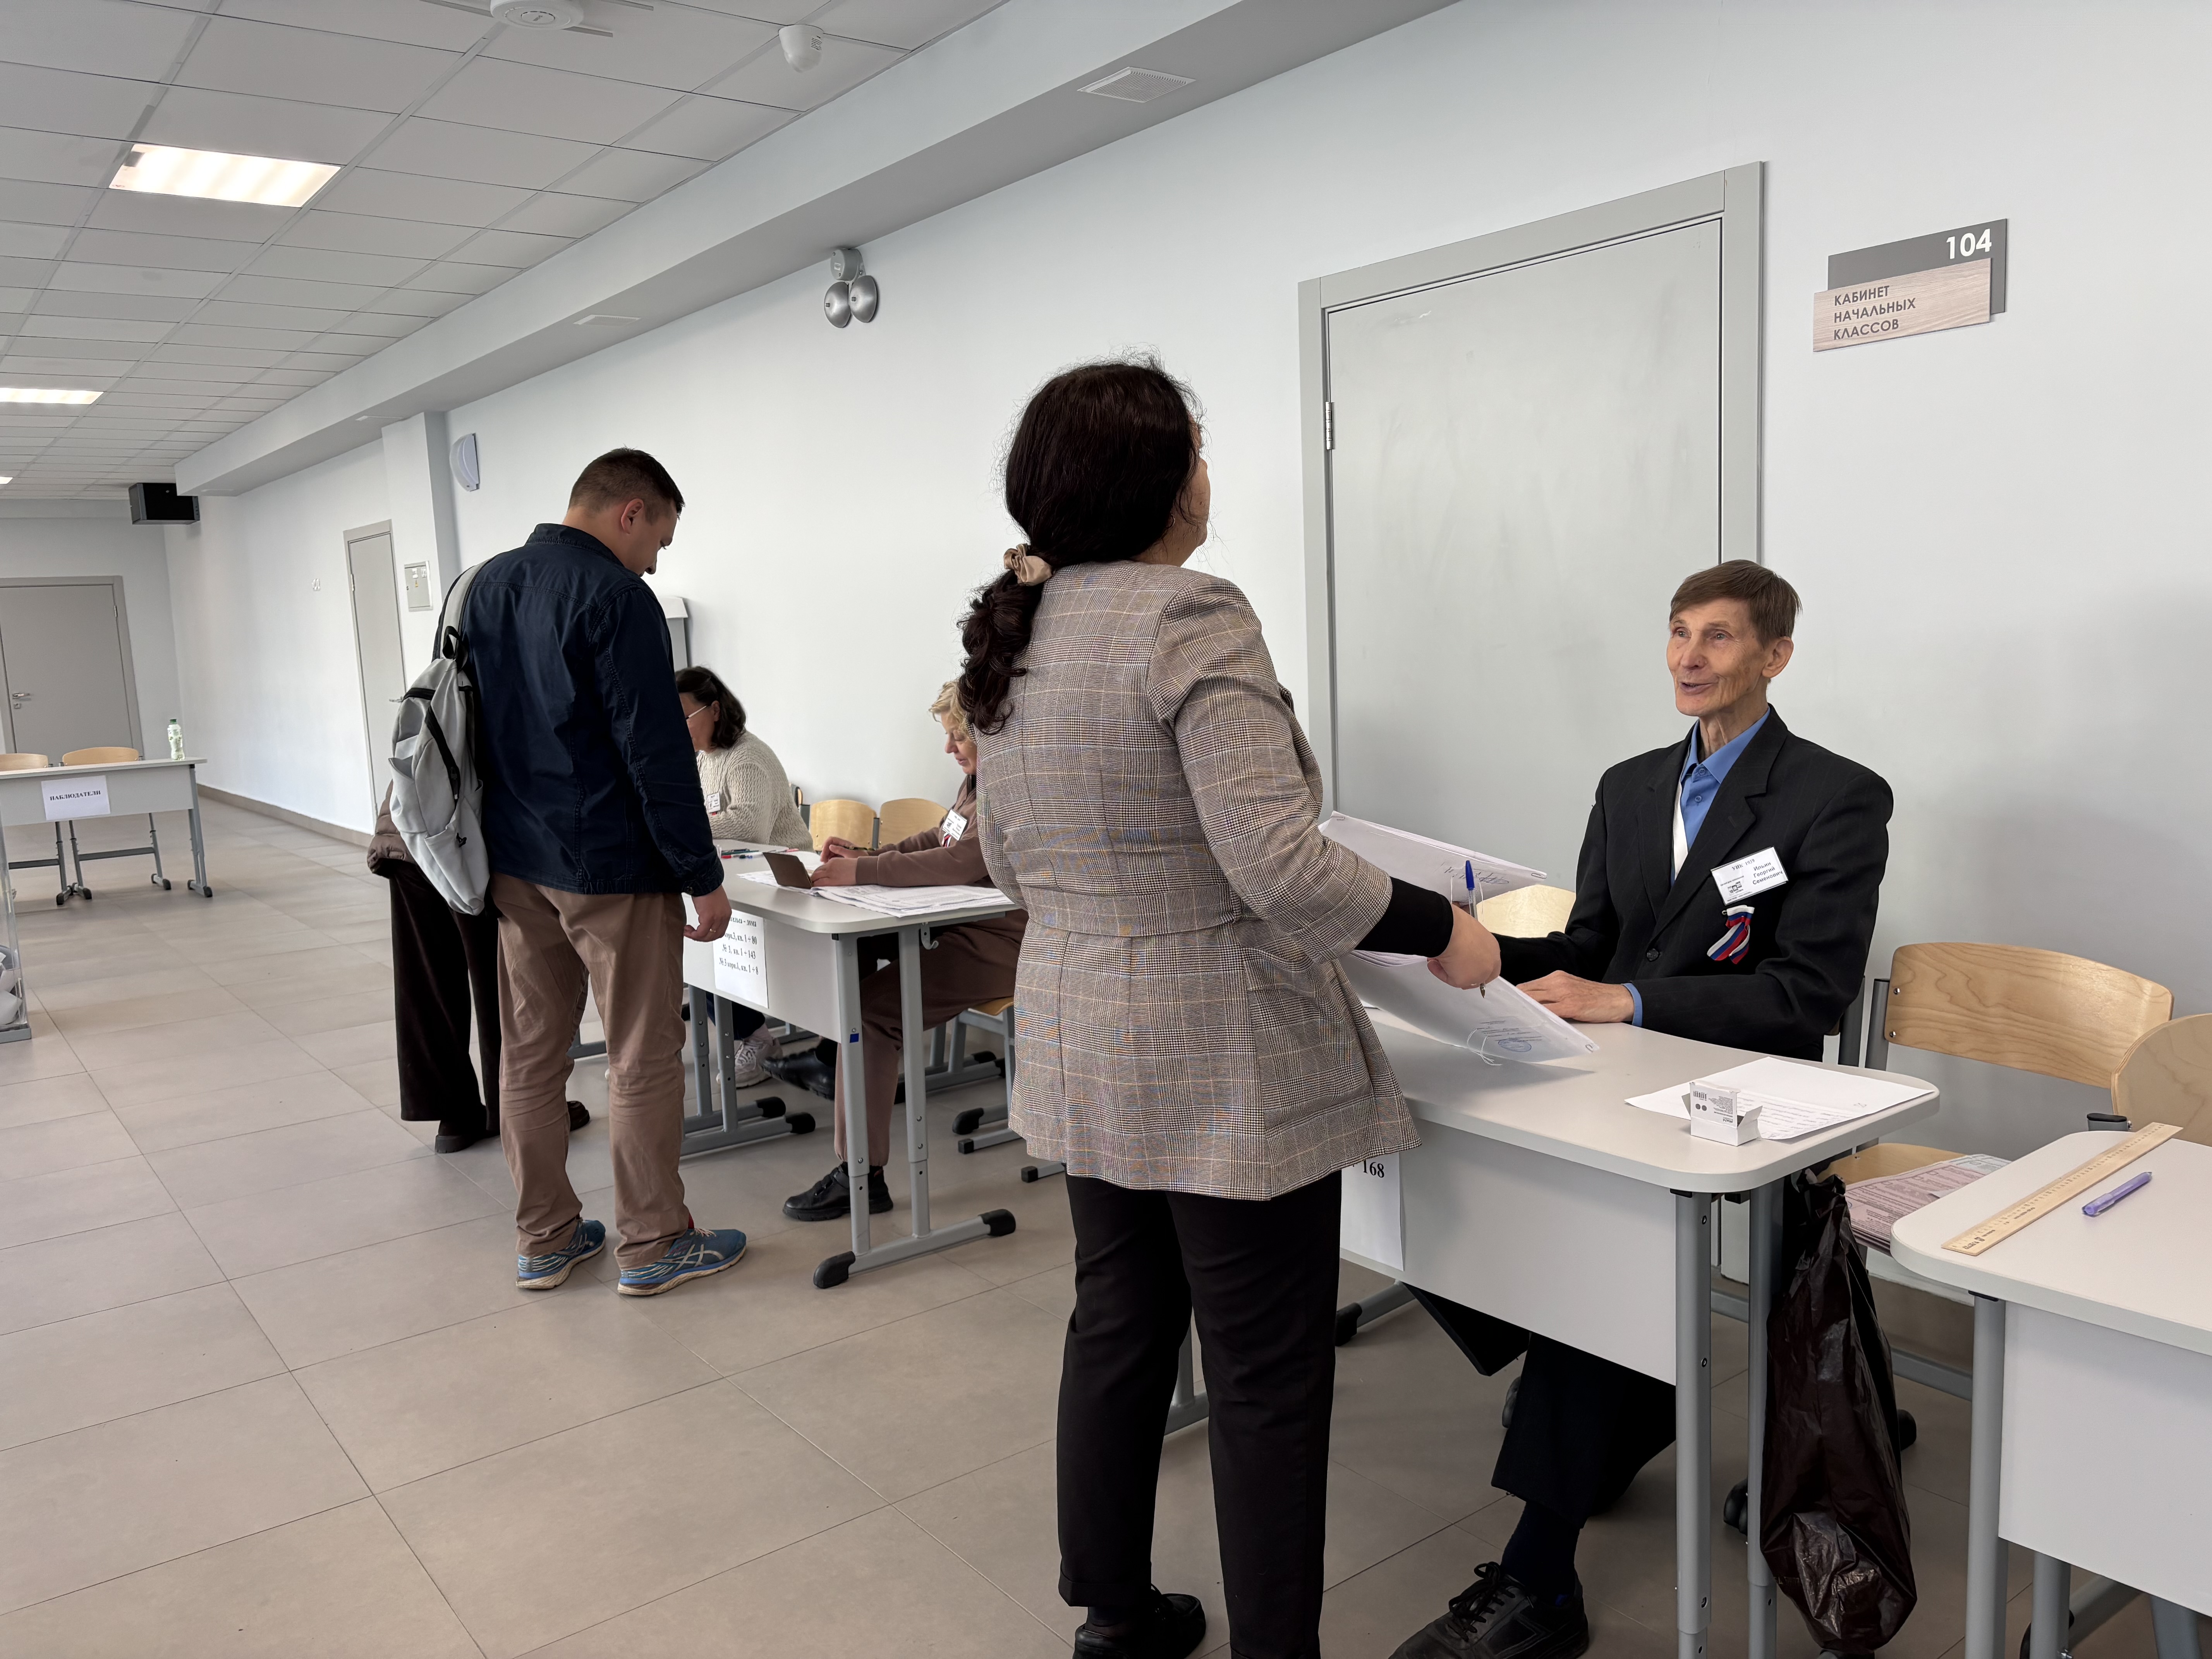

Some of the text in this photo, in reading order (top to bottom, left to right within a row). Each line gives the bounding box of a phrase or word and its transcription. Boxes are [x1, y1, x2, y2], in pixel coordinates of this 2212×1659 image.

[1946, 228, 1992, 259] 104
[1834, 285, 1890, 306] КАБИНЕТ
[1834, 298, 1916, 323] НАЧАЛЬНЫХ
[1834, 319, 1899, 340] КЛАССОВ
[50, 790, 101, 801] НАБЛЮДАТЕЛИ
[1753, 862, 1771, 871] Ильин
[1753, 866, 1776, 878] Георгий
[1753, 871, 1783, 885] Семенович
[752, 936, 757, 945] 80
[756, 967, 759, 975] 8
[1363, 1159, 1384, 1178] 168
